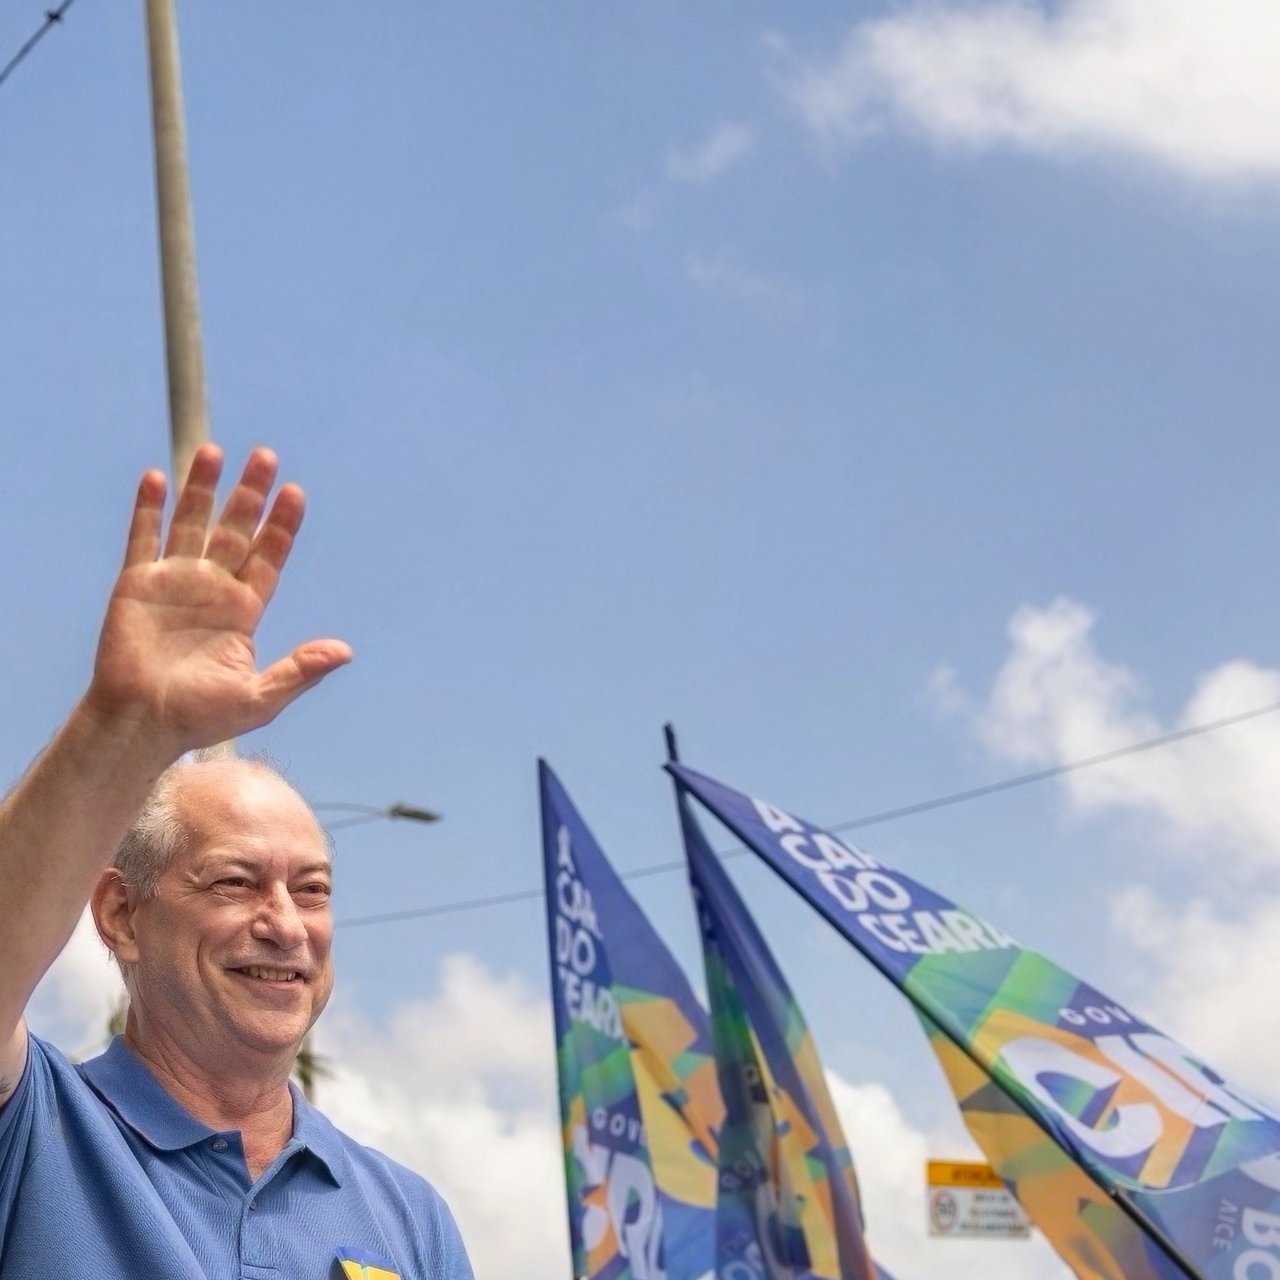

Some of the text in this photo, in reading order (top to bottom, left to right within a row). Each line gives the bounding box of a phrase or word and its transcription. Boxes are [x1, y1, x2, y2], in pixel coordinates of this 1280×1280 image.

[751, 798, 806, 833] A
[816, 870, 912, 911] DO
[555, 914, 597, 977] DO
